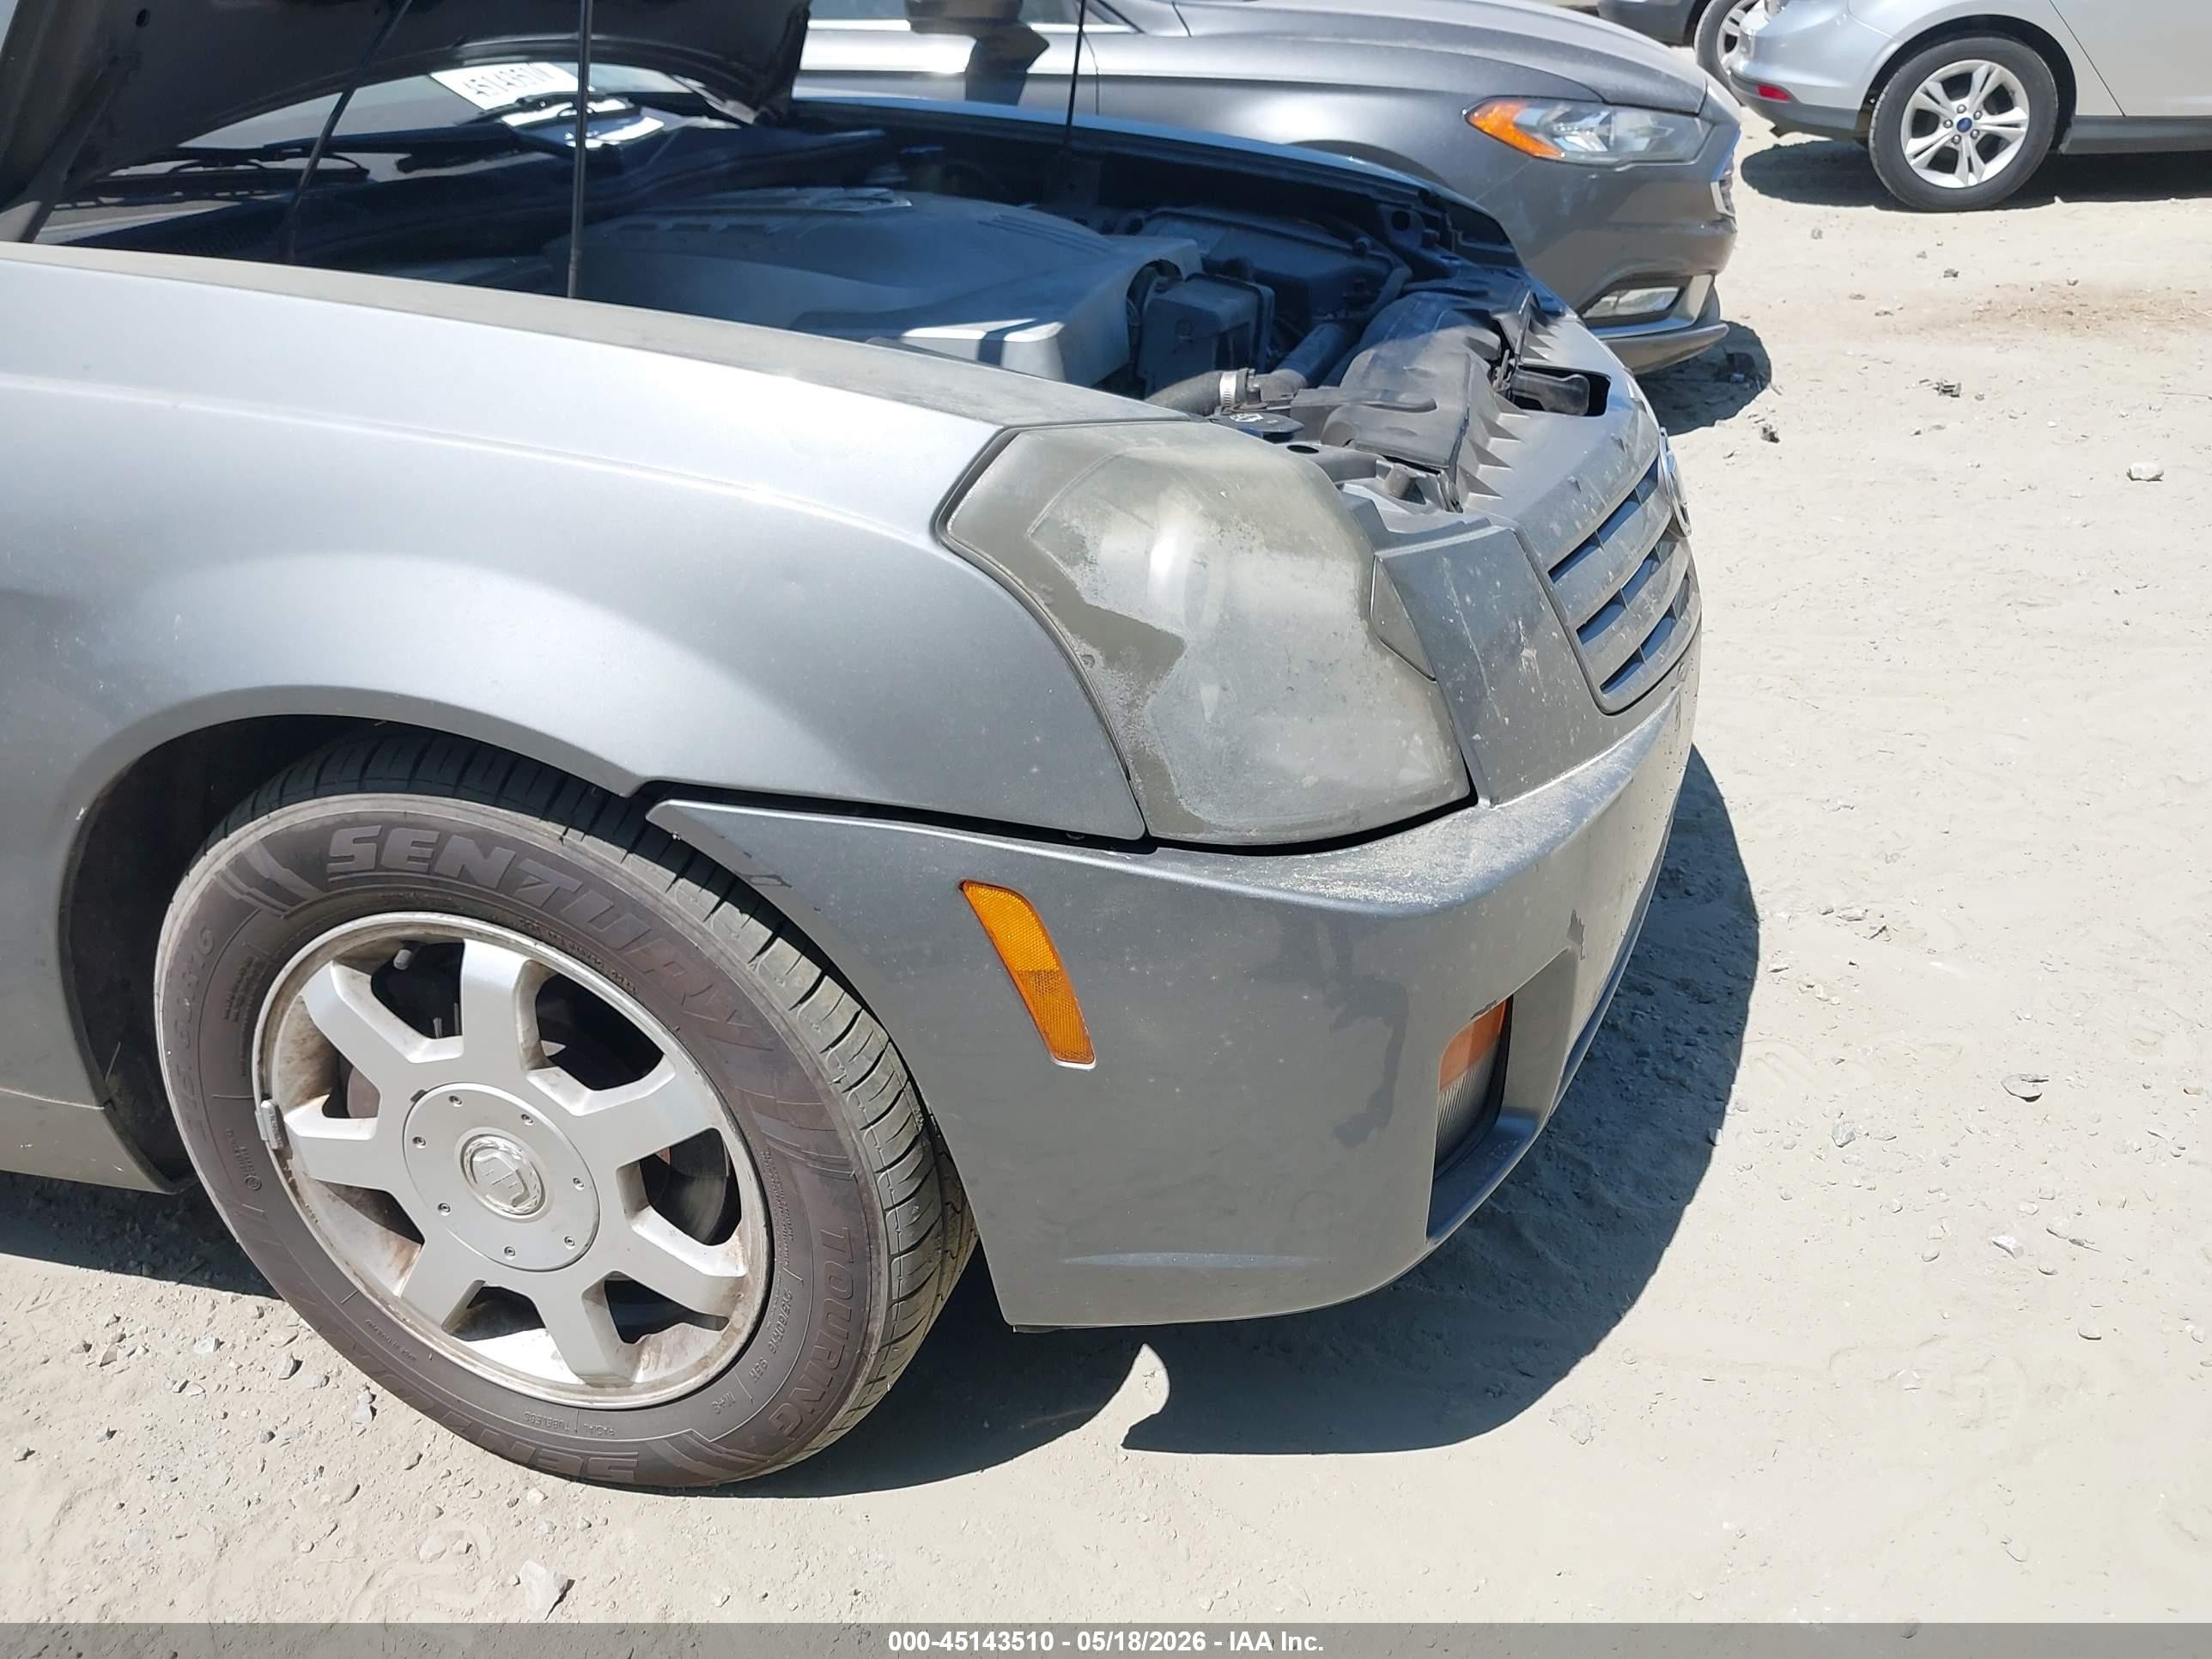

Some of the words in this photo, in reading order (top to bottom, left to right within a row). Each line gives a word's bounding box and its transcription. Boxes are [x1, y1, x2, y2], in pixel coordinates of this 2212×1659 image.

[327, 824, 775, 1052] SENTURY
[769, 1226, 854, 1441] TOURING
[524, 1411, 570, 1431] TUBELESS
[583, 1423, 616, 1436] RADIAL
